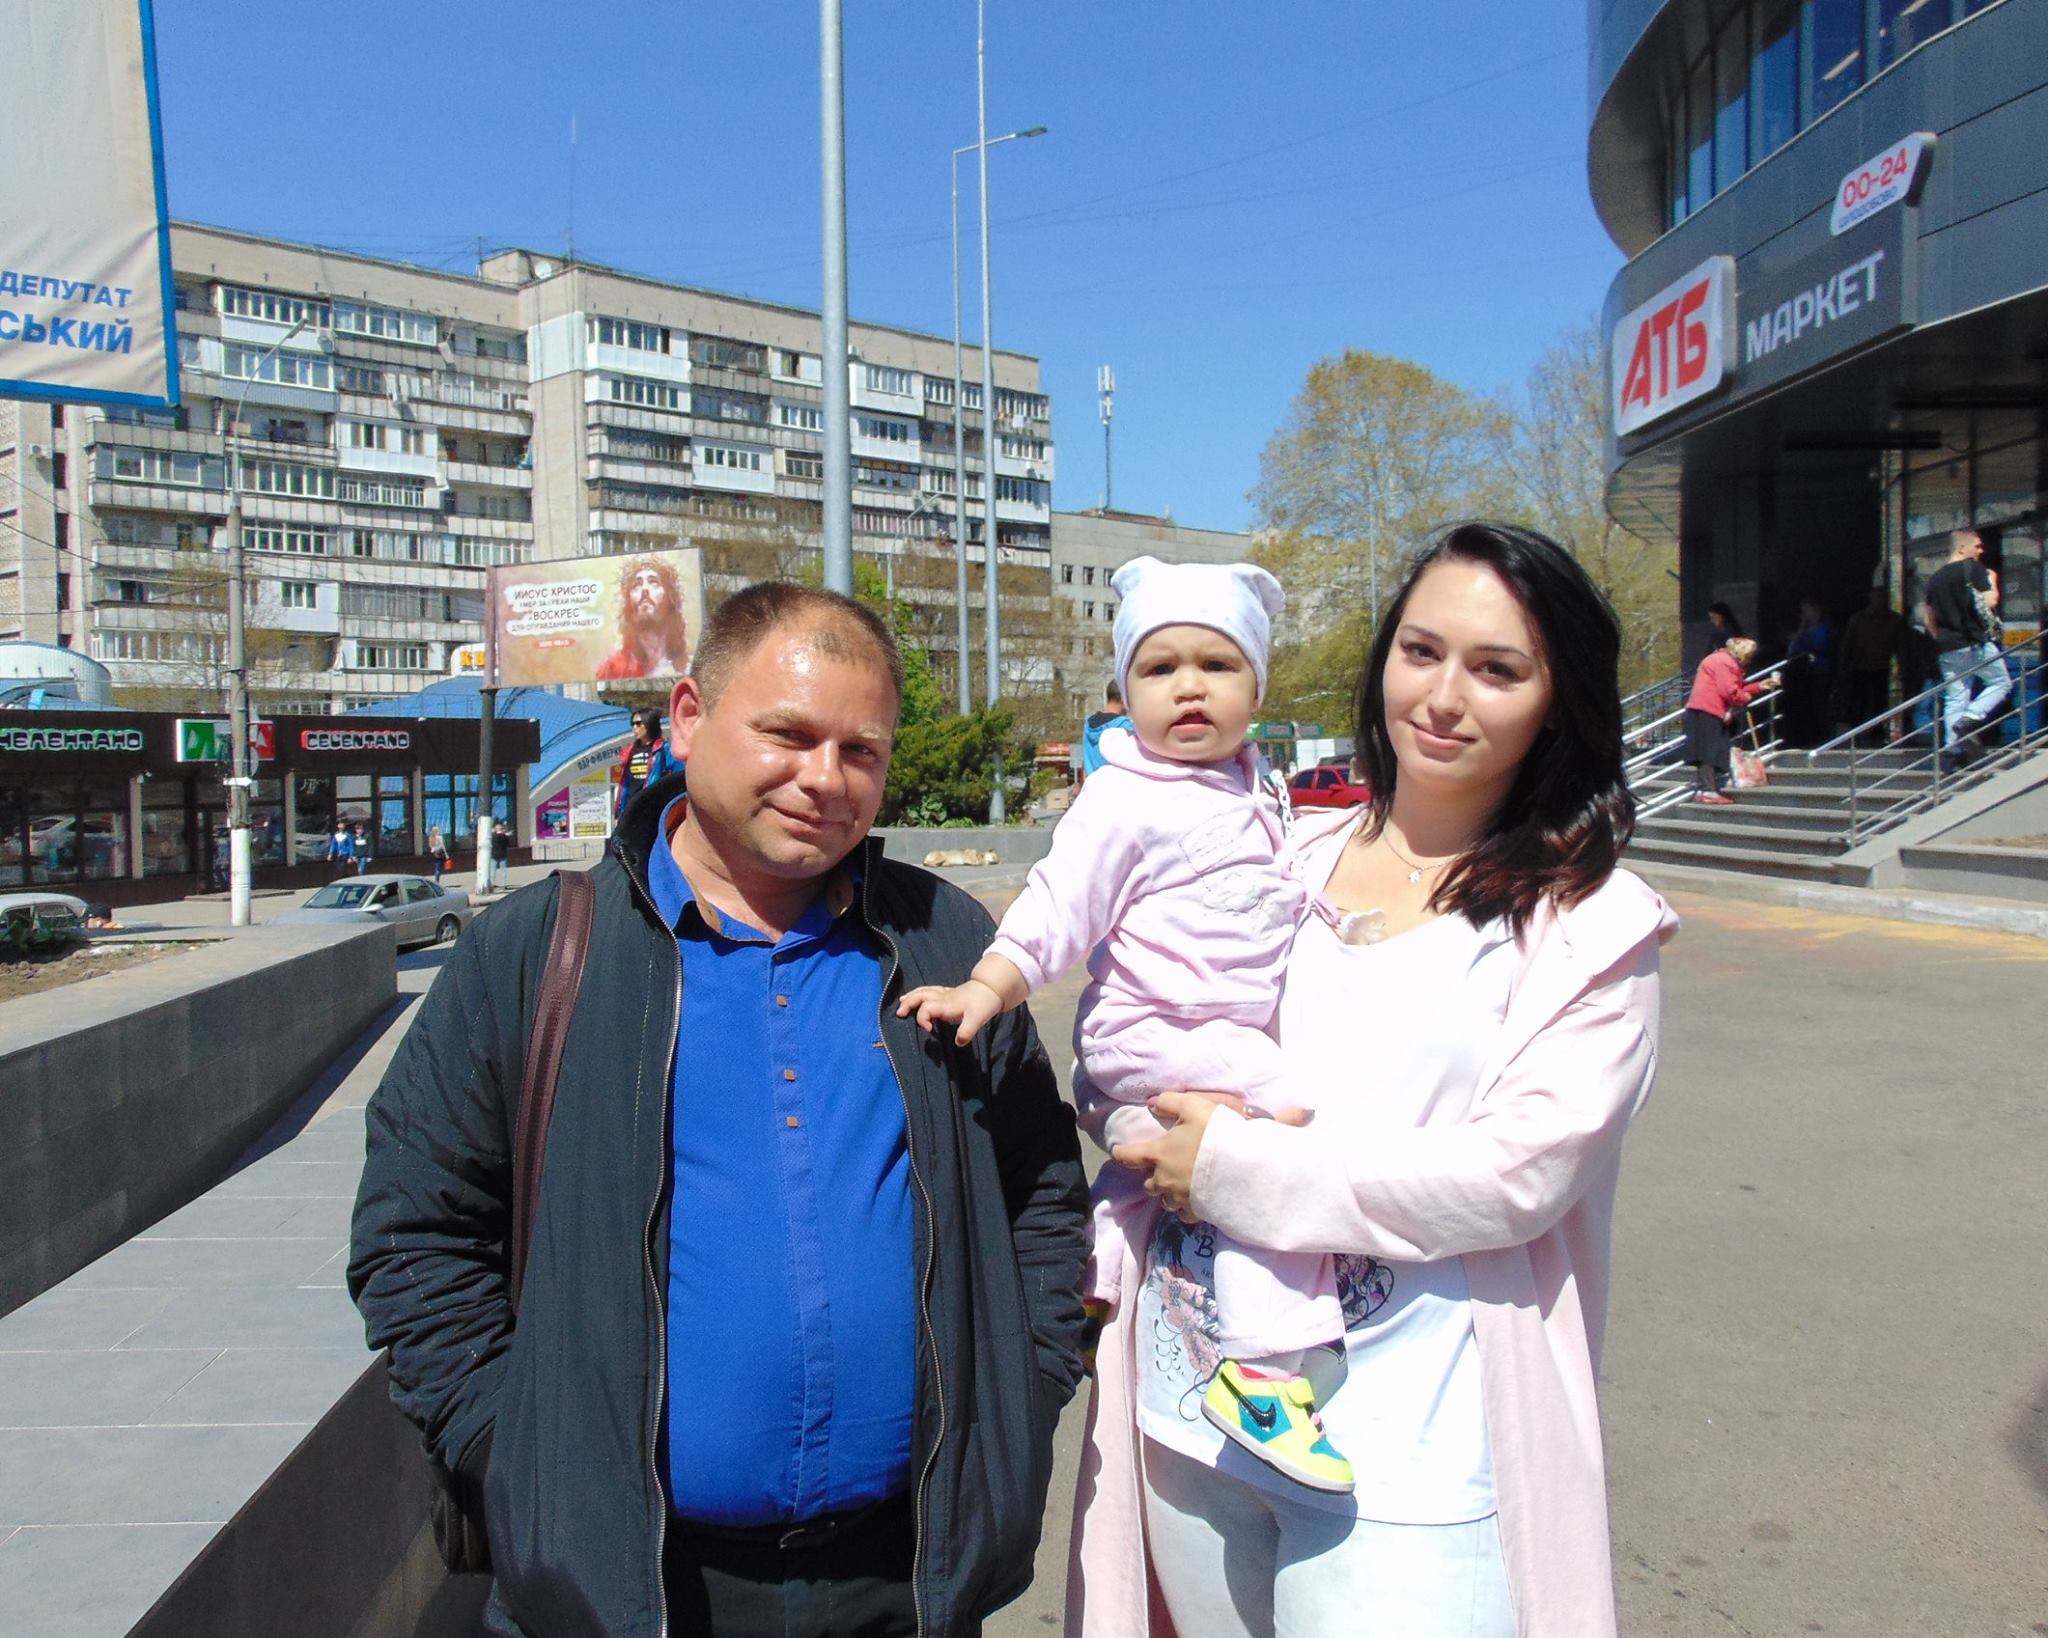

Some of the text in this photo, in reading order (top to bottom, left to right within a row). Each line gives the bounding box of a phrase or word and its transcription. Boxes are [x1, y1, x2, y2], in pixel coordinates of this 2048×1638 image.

[1843, 147, 1908, 209] 00-24
[0, 270, 132, 308] ДЕПУТАТ
[1746, 250, 1884, 363] МАРКЕТ
[0, 309, 133, 354] СЬКИЙ
[1621, 276, 1712, 416] АТБ
[514, 584, 597, 600] ИИСУС ХРИСТОС
[533, 608, 580, 621] ВОСКРЕС
